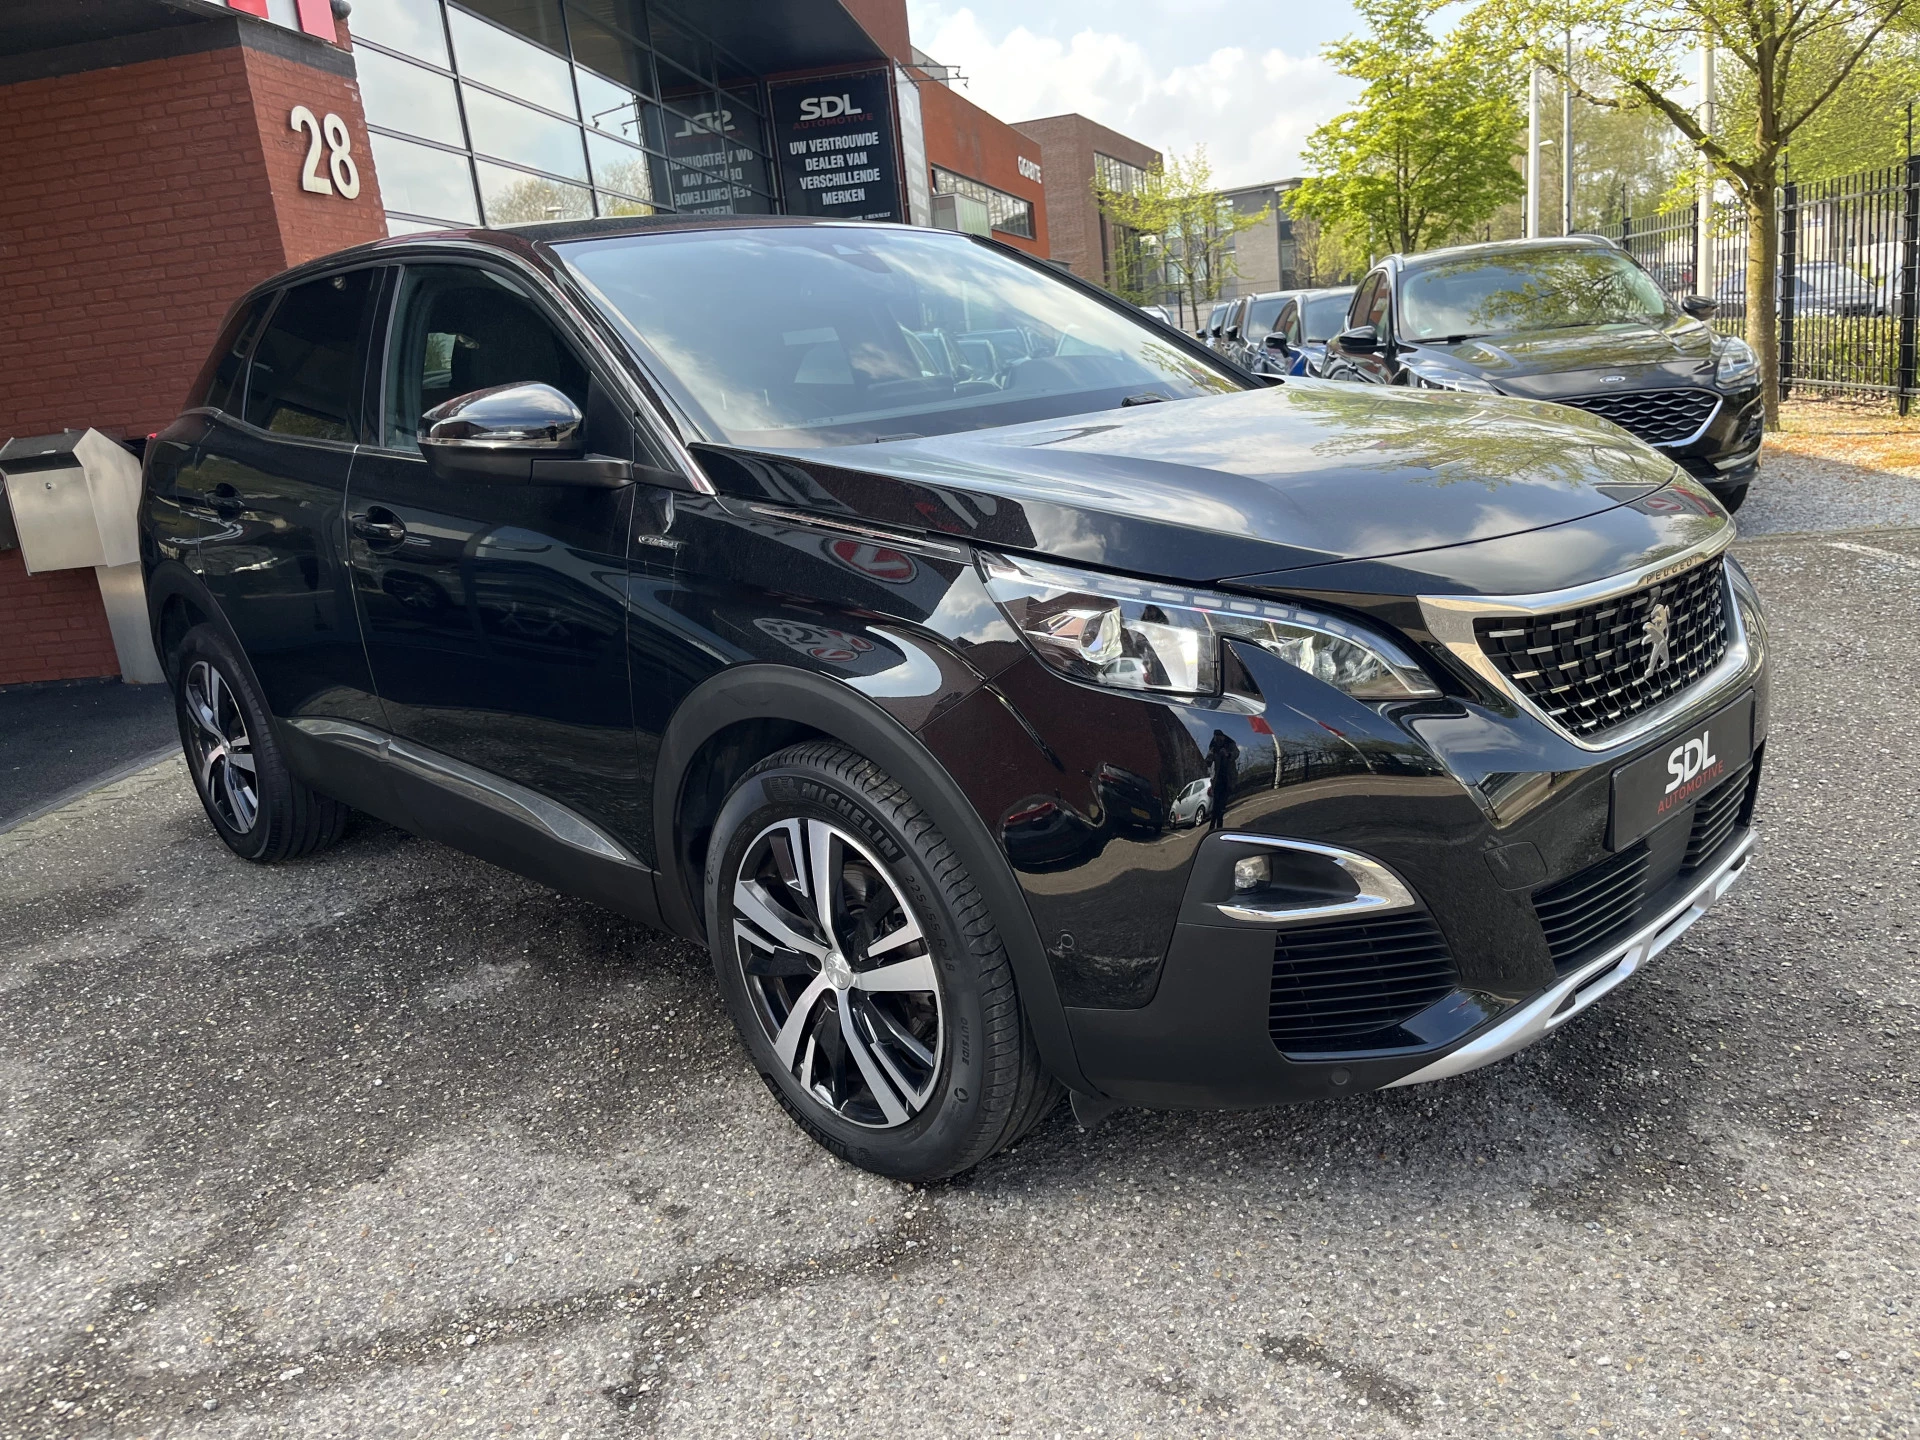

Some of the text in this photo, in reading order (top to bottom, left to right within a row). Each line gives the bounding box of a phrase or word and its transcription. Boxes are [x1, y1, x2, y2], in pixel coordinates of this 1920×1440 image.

[792, 113, 873, 130] AUTOMOTIVE
[800, 94, 862, 121] SDL
[290, 105, 361, 199] 28
[790, 132, 879, 155] UW VERTROUWDE
[805, 152, 868, 172] DEALER VAN
[800, 168, 880, 190] VERSCHILLENDE
[822, 188, 866, 206] MERKEN
[1646, 555, 1698, 584] PEUGEOT
[1665, 730, 1716, 795] SDL
[1657, 760, 1724, 815] AUTOMOTIVE
[801, 782, 898, 858] MICHELIN
[961, 1016, 970, 1066] OUTSIDE
